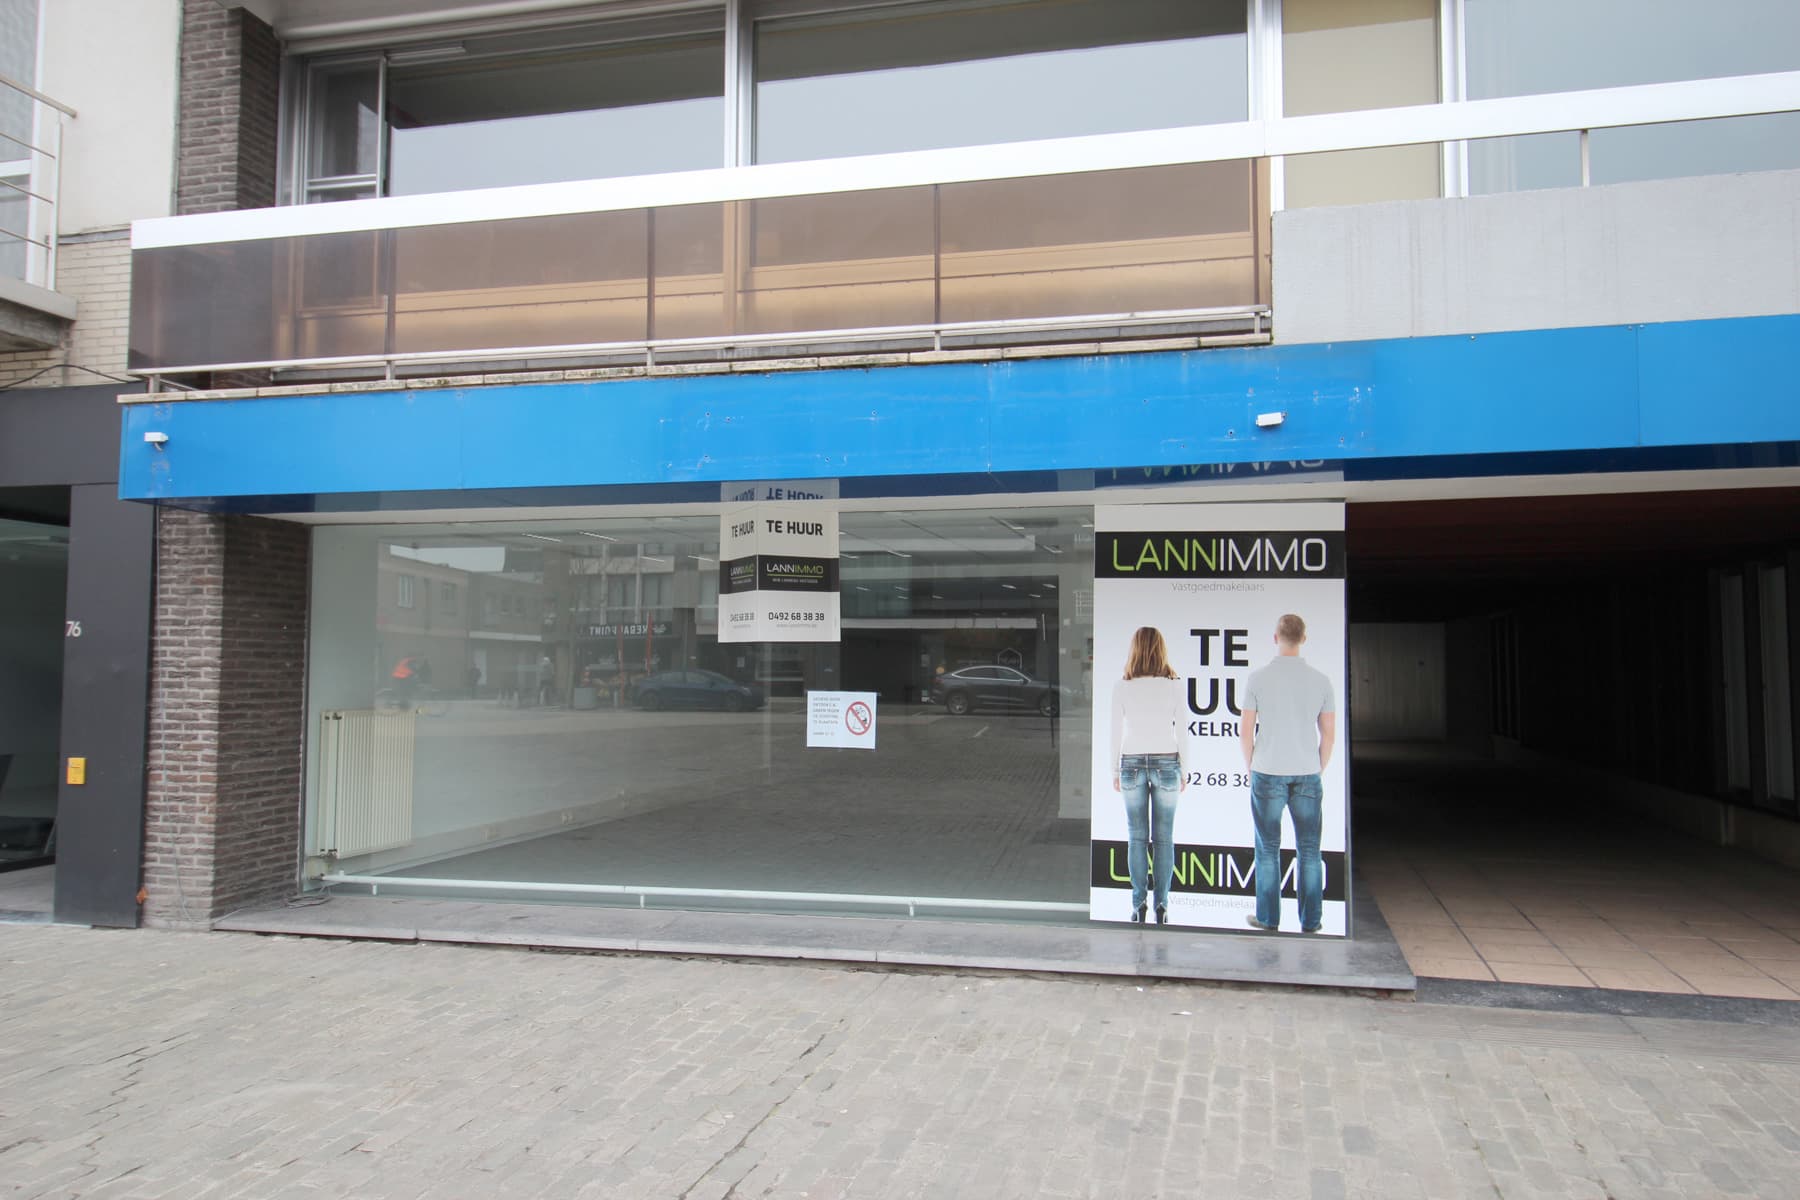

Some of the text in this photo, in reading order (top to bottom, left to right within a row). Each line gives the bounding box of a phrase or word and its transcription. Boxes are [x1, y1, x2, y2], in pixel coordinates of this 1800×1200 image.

[731, 520, 755, 538] TE HUUR
[766, 520, 823, 536] TE HUUR
[1112, 538, 1327, 572] LANNIMMO
[766, 563, 824, 575] LANNIMMO
[1171, 581, 1265, 593] Vastgoedmakelaars
[768, 612, 825, 621] 0492 68 38 38
[66, 620, 82, 637] 76
[1190, 628, 1249, 667] TE
[1187, 677, 1242, 717] UU
[1207, 773, 1228, 787] 68
[1168, 895, 1255, 909] Vastgoedmakelaa
